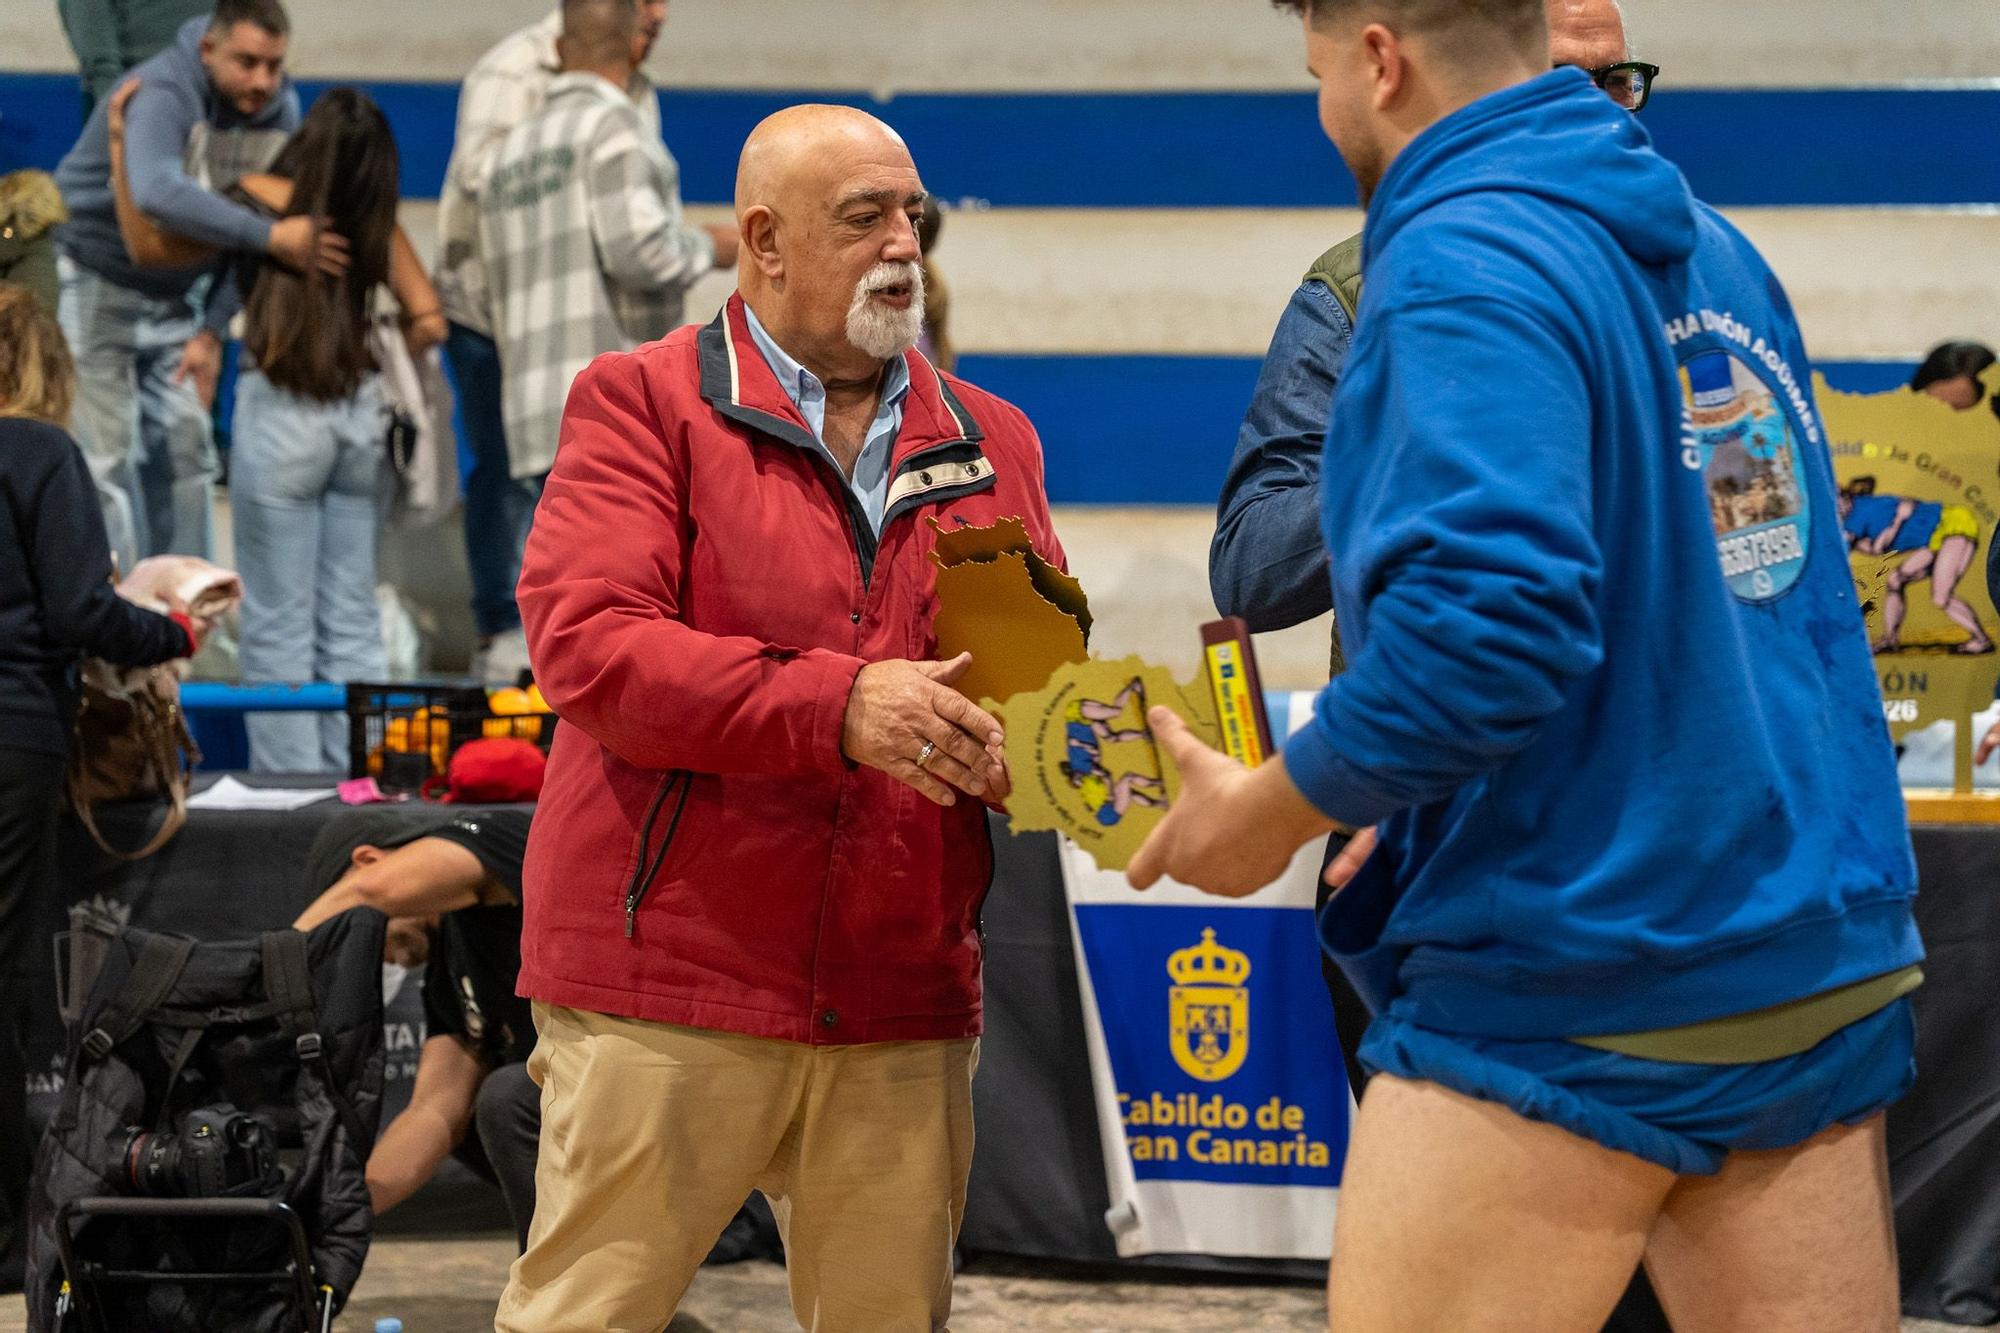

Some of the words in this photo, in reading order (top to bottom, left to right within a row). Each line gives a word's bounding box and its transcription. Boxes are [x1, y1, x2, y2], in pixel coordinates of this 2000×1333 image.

[1665, 312, 1701, 345] HA
[1964, 484, 1997, 525] Can
[1882, 665, 1929, 693] ÓN
[1883, 698, 1919, 722] 26
[1256, 1096, 1305, 1131] de
[1187, 1129, 1330, 1167] Canaria
